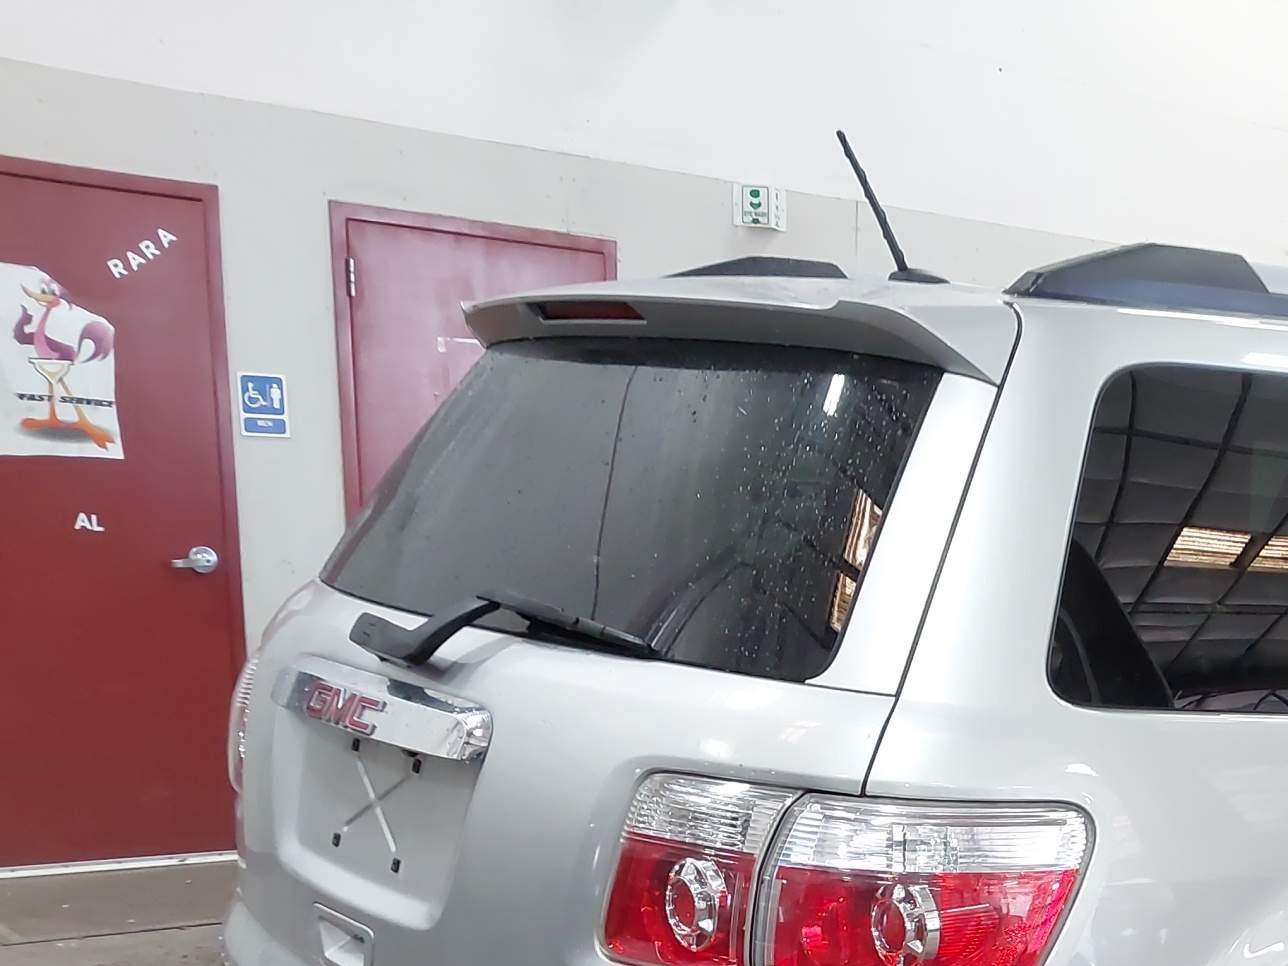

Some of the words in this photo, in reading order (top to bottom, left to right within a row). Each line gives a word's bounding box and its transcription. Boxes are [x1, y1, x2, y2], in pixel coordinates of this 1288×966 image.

[106, 228, 178, 279] RARA
[74, 512, 105, 531] AL
[305, 680, 387, 736] GMC
